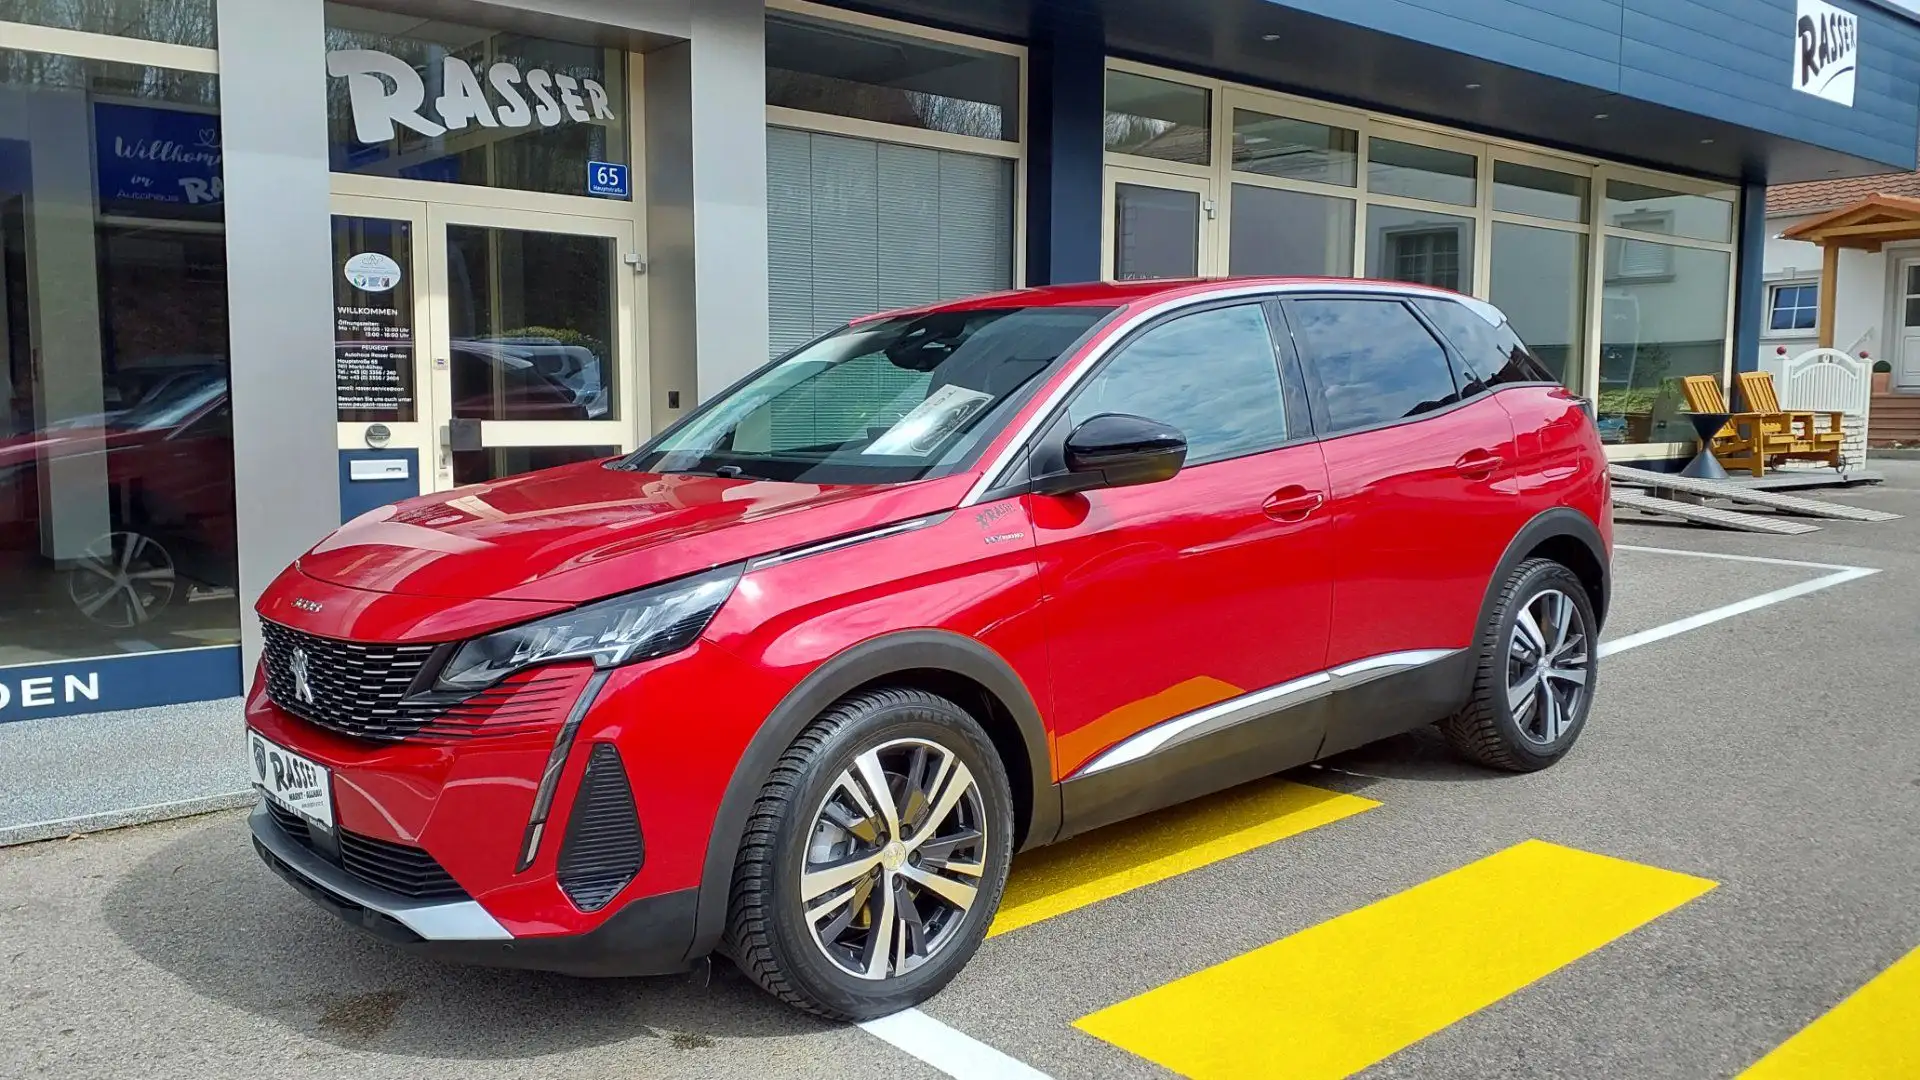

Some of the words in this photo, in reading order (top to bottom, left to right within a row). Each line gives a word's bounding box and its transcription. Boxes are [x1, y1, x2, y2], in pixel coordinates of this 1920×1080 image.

[1798, 12, 1855, 87] RASSER
[326, 50, 615, 144] RASSER
[597, 166, 618, 186] 65
[337, 306, 398, 316] WILLKOMMEN
[269, 751, 318, 792] RASSER
